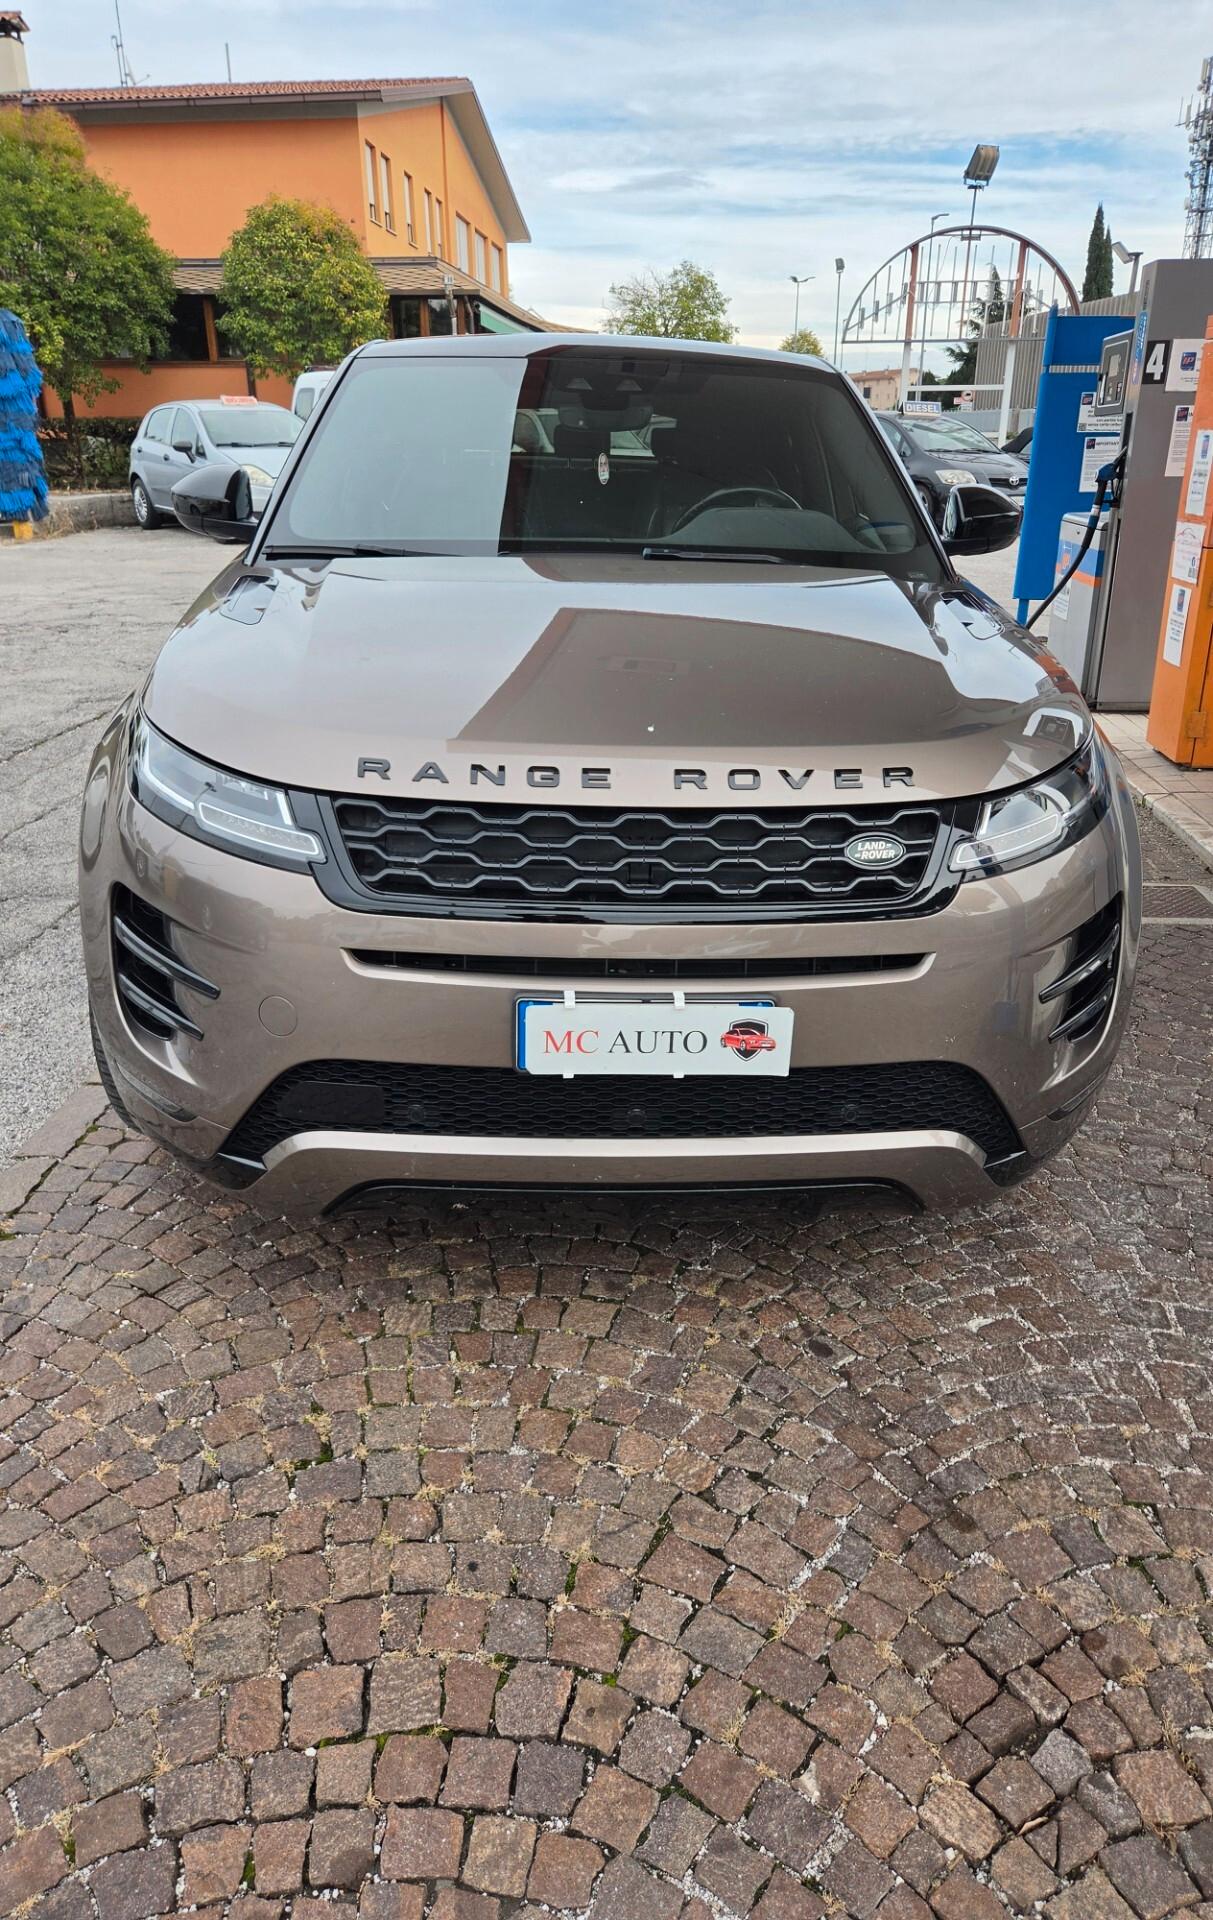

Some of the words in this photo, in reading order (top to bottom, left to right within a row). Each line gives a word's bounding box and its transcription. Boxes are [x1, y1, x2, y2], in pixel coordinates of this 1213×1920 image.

[1145, 343, 1166, 380] 4
[905, 402, 940, 413] DIESEL
[357, 756, 612, 790] RANGE
[673, 766, 915, 791] ROVER
[543, 1030, 599, 1054] MC
[608, 1030, 708, 1054] AUTO
